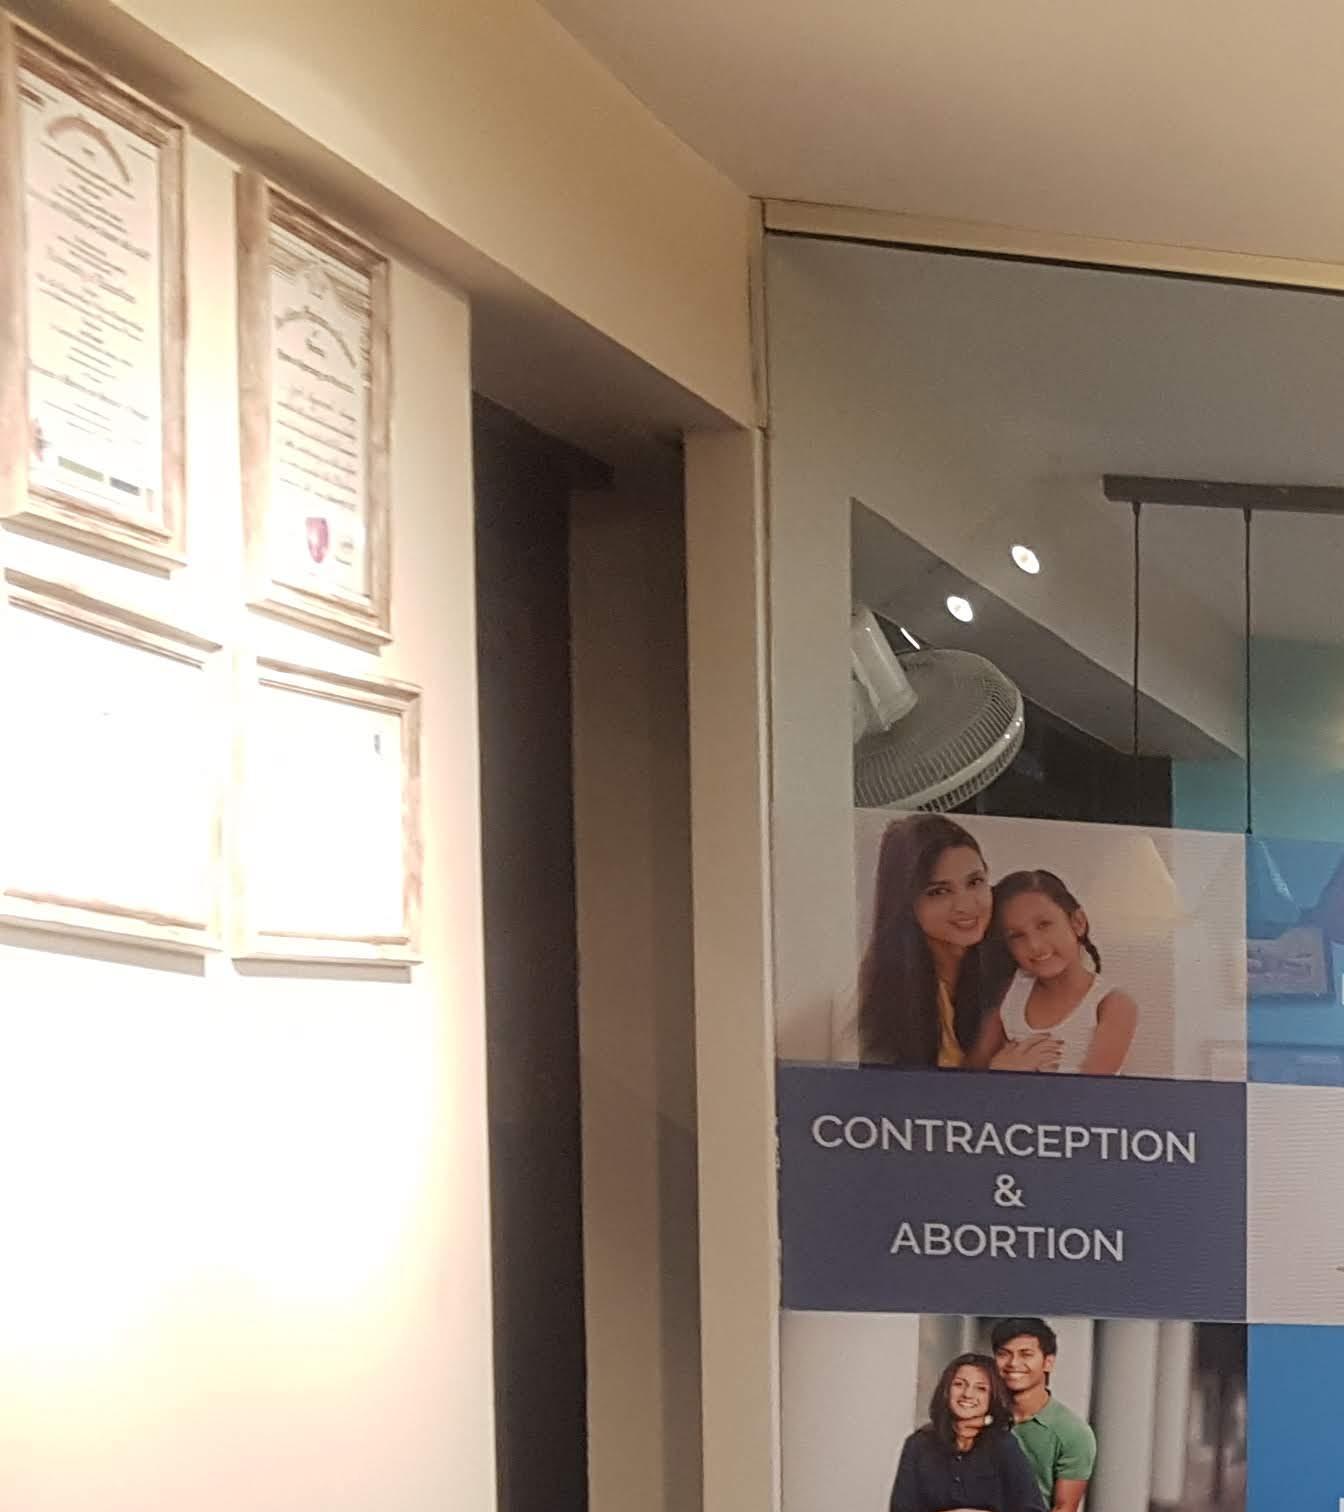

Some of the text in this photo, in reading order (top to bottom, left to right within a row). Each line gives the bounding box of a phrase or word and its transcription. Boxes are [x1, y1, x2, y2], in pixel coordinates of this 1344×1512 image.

[811, 1113, 1197, 1164] CONTRACEPTION
[992, 1174, 1025, 1207] &
[889, 1221, 1125, 1262] ABORTION
